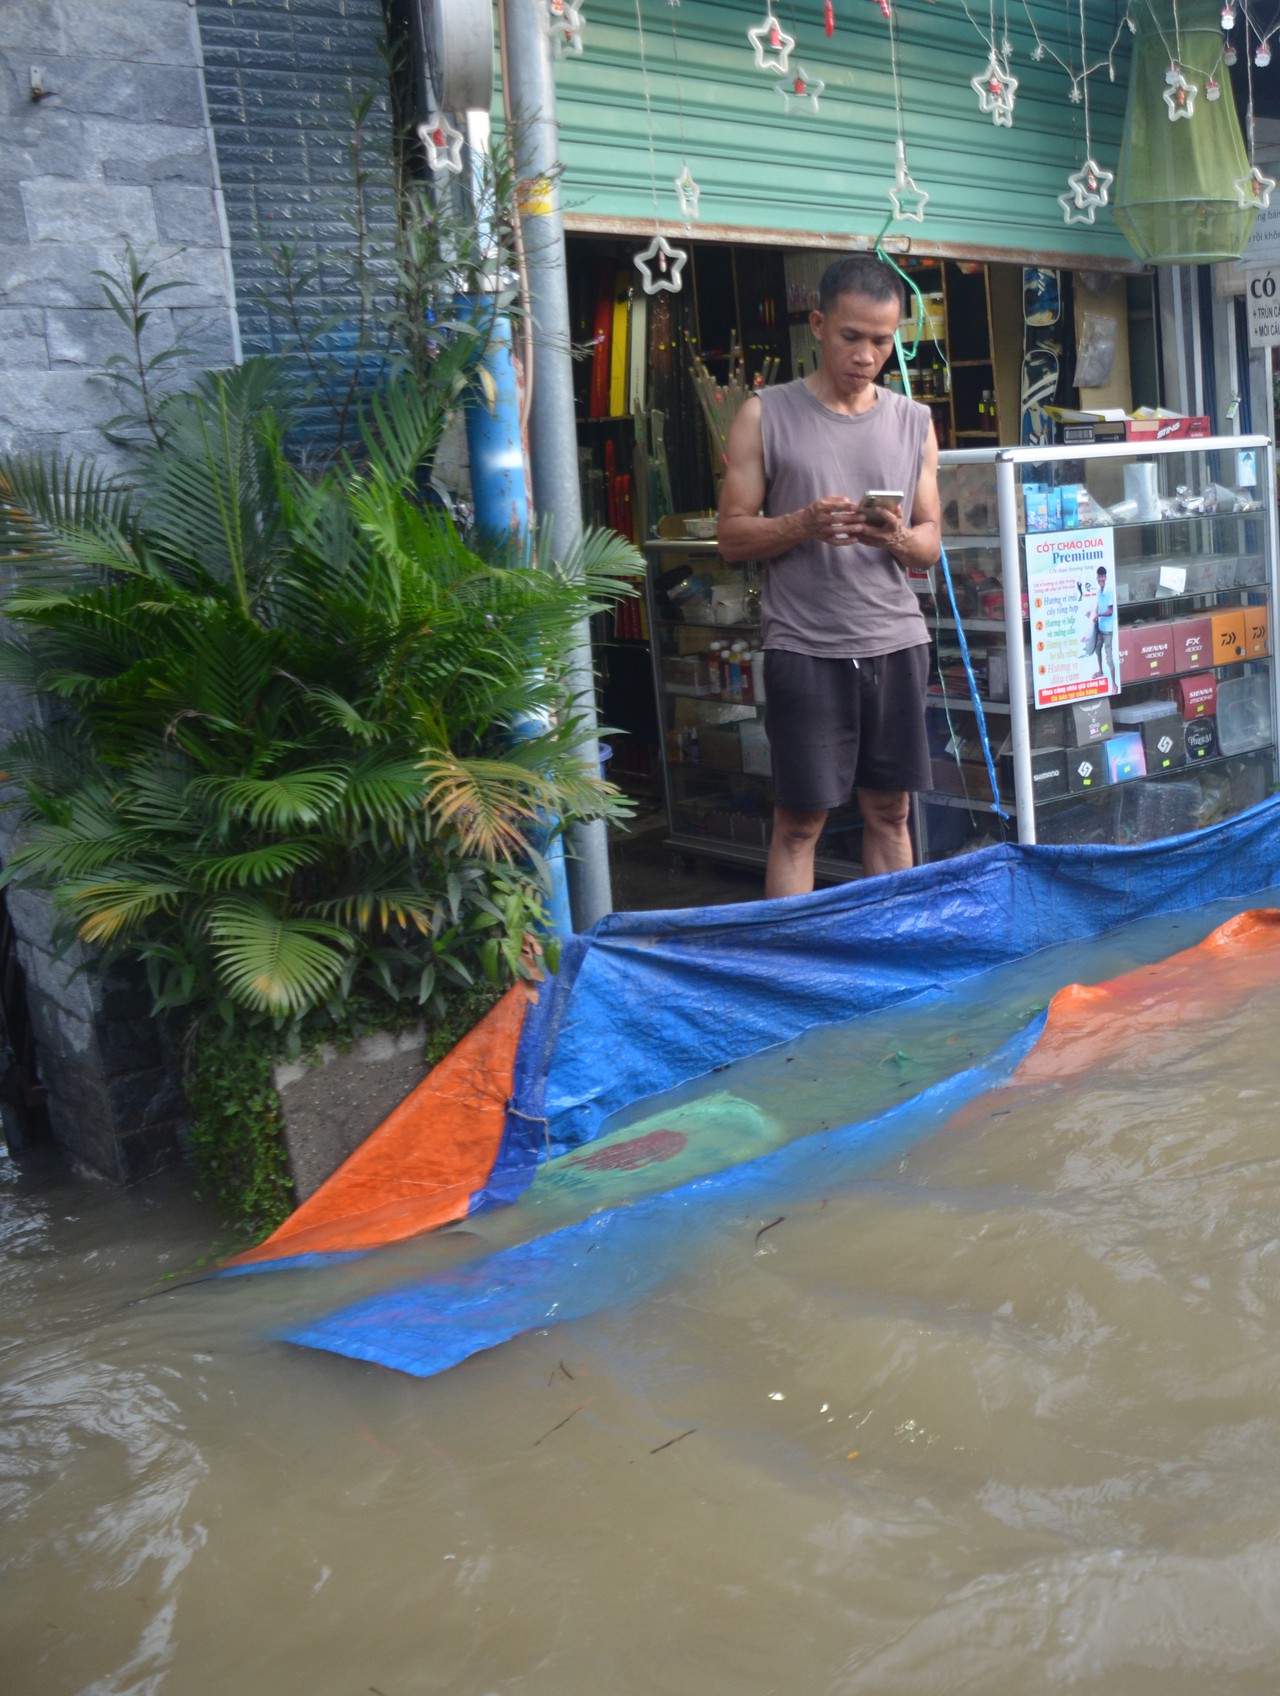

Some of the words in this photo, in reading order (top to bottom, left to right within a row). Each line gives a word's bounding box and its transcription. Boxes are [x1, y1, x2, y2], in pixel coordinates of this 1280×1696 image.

[1267, 209, 1280, 219] bán
[1250, 271, 1276, 299] CÓ
[1052, 549, 1103, 564] Premium
[1185, 636, 1201, 646] FX
[1141, 643, 1168, 654] SIENNA
